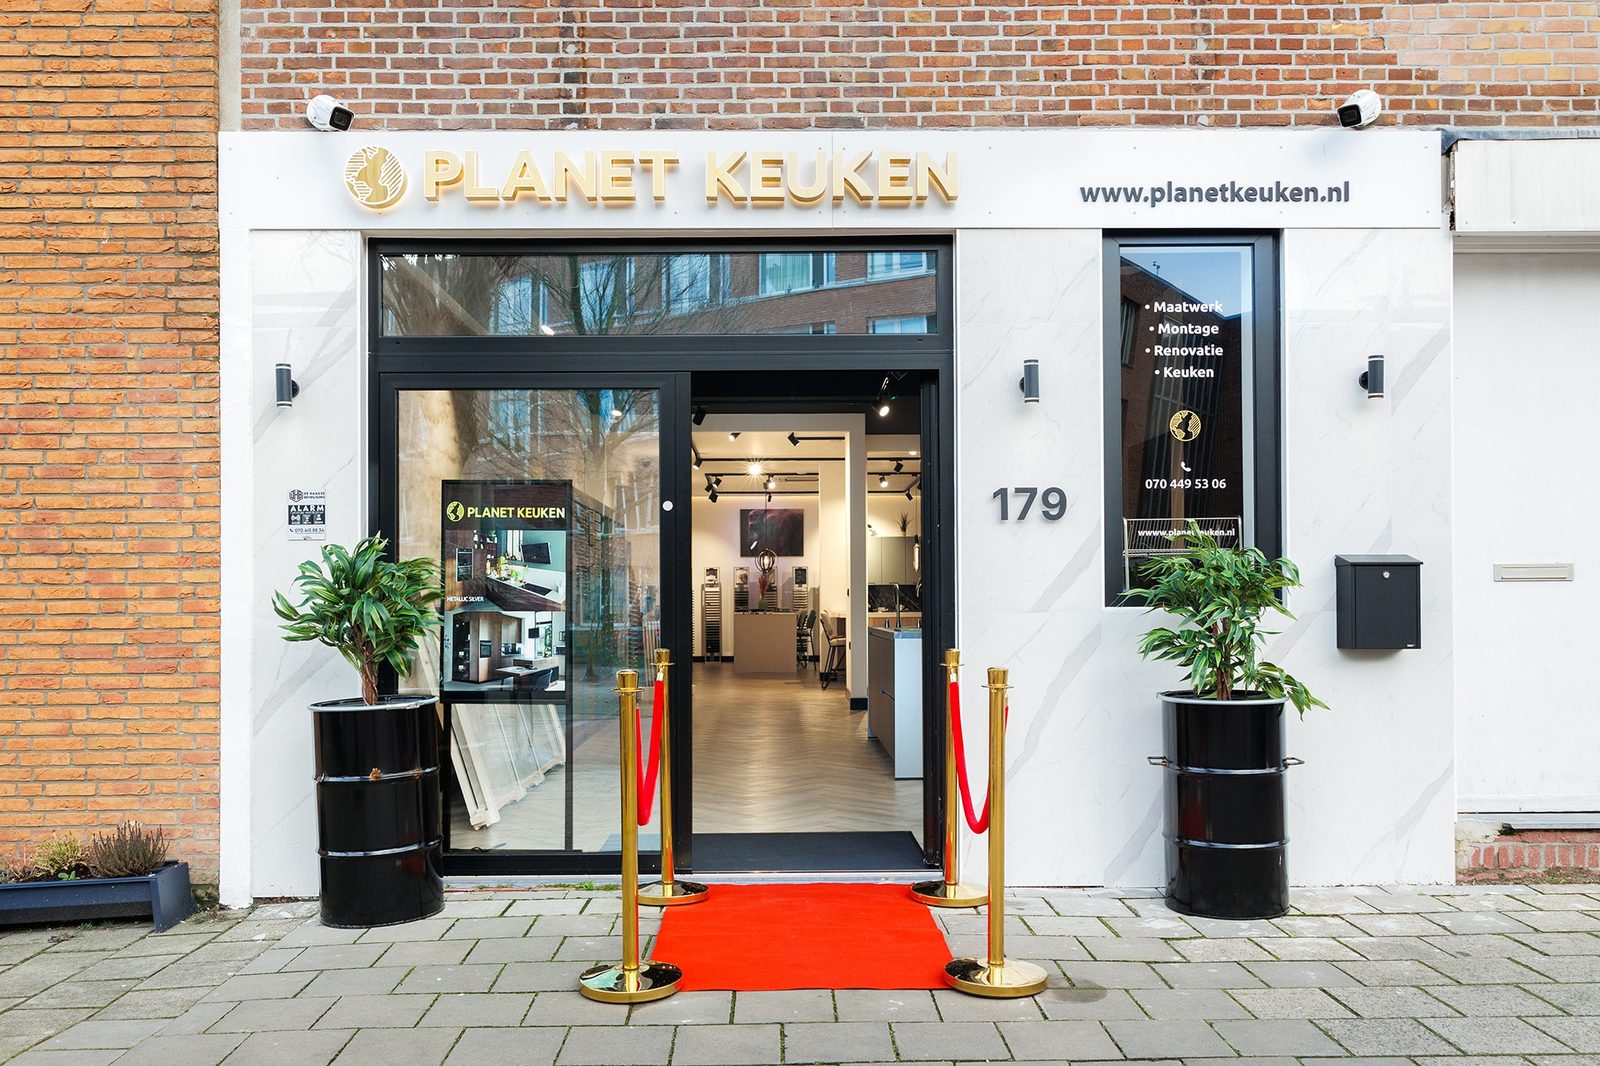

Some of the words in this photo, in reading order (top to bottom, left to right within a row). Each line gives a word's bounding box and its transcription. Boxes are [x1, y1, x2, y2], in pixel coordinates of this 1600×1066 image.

[424, 150, 679, 204] PLANET
[705, 150, 960, 204] KEUKEN
[1080, 181, 1350, 208] www.planetkeuken.nl
[1153, 300, 1224, 313] Maatwerk
[1158, 323, 1220, 336] Montage
[1154, 344, 1224, 357] Renovatie
[1163, 366, 1215, 378] Keuken
[1145, 478, 1168, 489] 070
[1169, 478, 1192, 489] 449
[1194, 478, 1209, 489] 53
[1211, 478, 1227, 489] 06
[290, 504, 325, 512] ALARM
[992, 486, 1068, 521] 179
[467, 506, 515, 518] PLANET
[516, 507, 566, 519] KEUKEN
